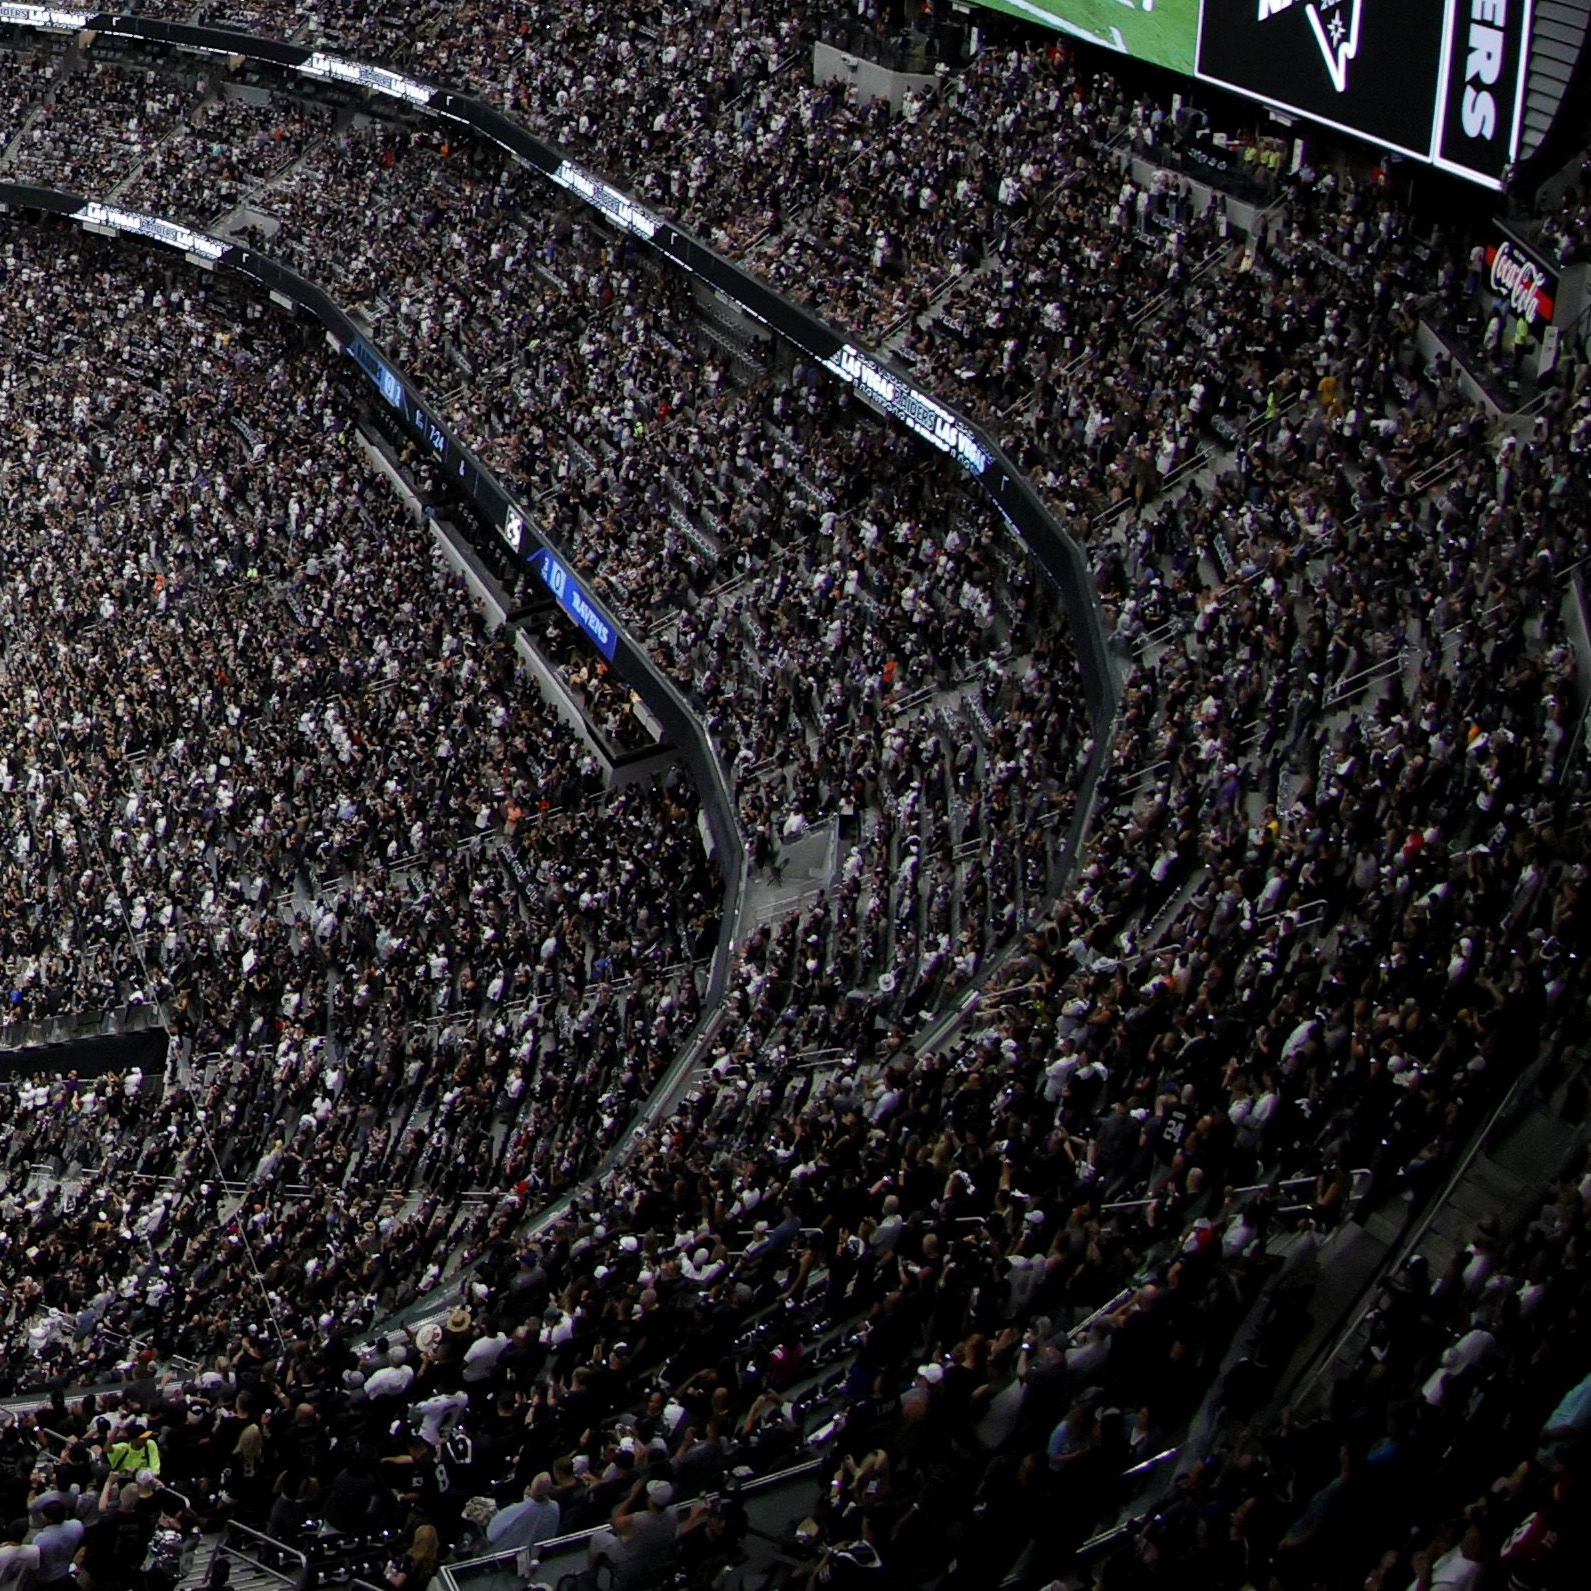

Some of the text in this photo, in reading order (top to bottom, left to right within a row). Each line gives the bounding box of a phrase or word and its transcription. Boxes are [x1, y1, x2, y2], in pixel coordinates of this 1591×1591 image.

[29, 11, 50, 22] LAS
[50, 13, 86, 26] VEGAS
[87, 207, 107, 223] LAS
[108, 211, 140, 230] VEGAS
[176, 231, 194, 248] LAS
[194, 236, 222, 258] VEGAS
[1490, 241, 1545, 324] Coca-Cola
[841, 353, 862, 382] LAS
[862, 369, 893, 402] VEGAS
[935, 418, 958, 447] LAS
[571, 589, 610, 645] RAVENS
[1163, 1119, 1184, 1143] 24
